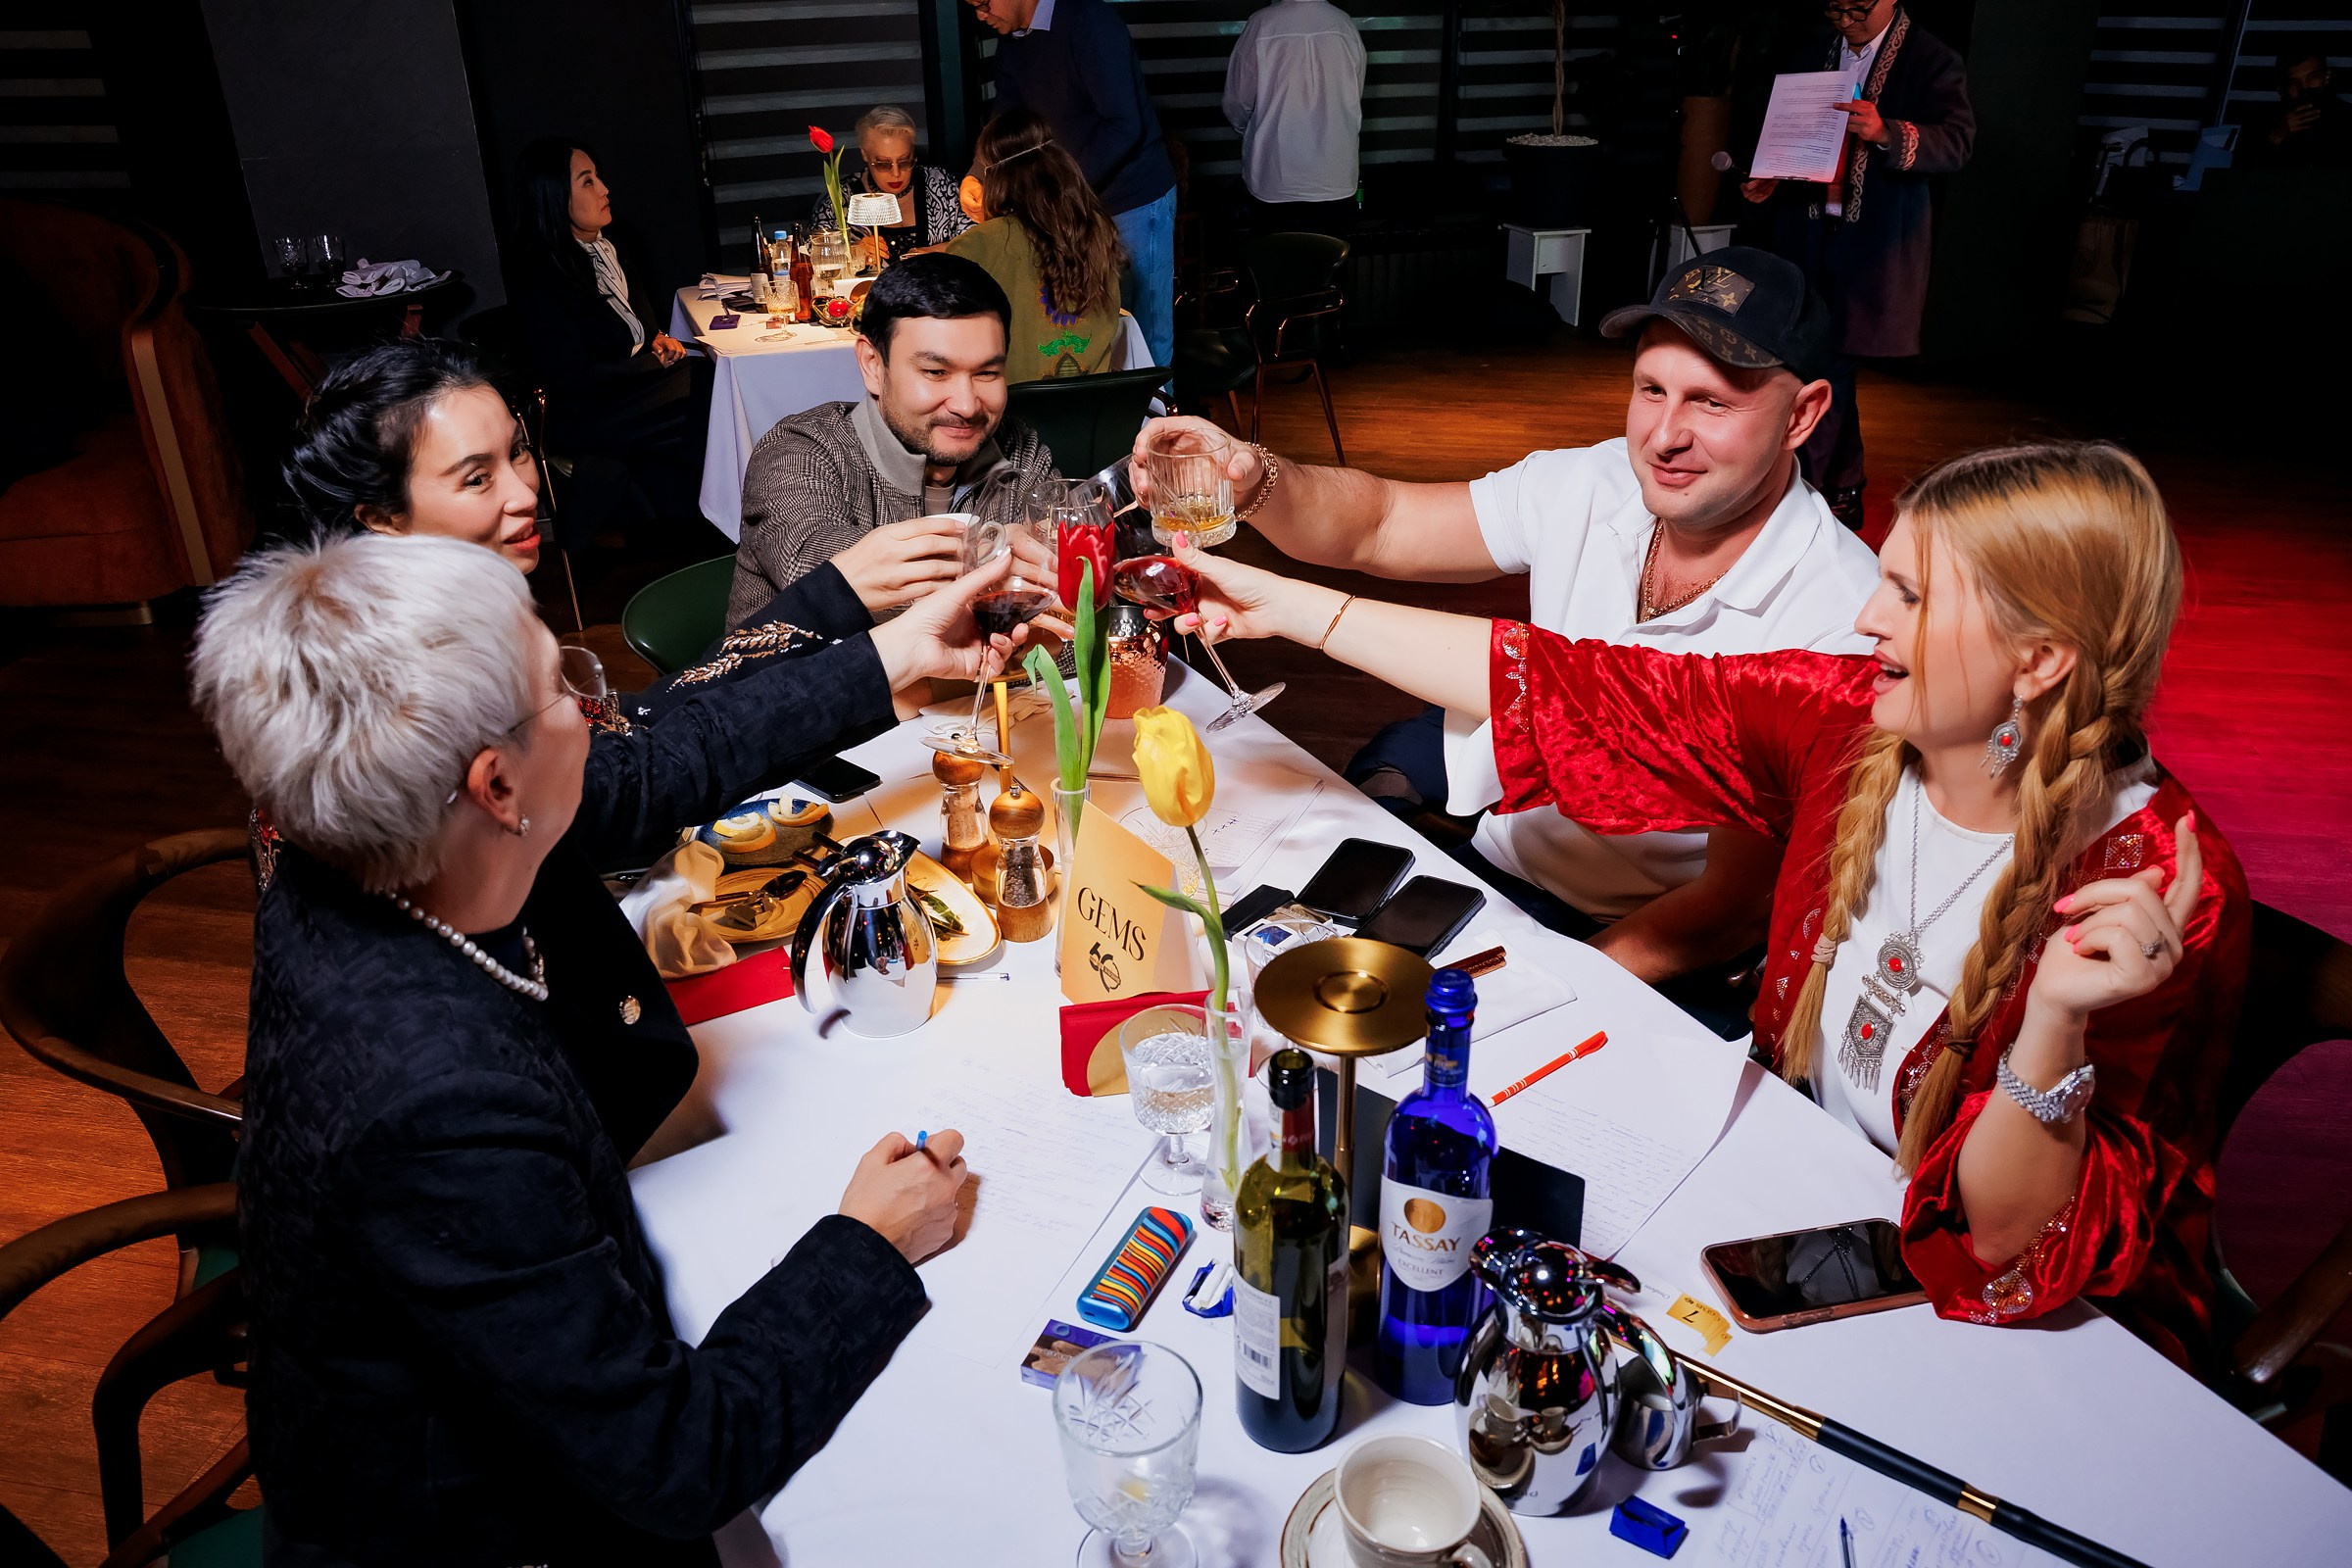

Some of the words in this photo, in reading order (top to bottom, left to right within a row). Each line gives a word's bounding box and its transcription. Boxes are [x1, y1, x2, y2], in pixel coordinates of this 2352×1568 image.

[1077, 887, 1147, 961] GEMS
[1391, 1220, 1461, 1253] TASSAY
[1397, 1258, 1445, 1275] EXCELLENT
[1682, 1310, 1699, 1324] 7
